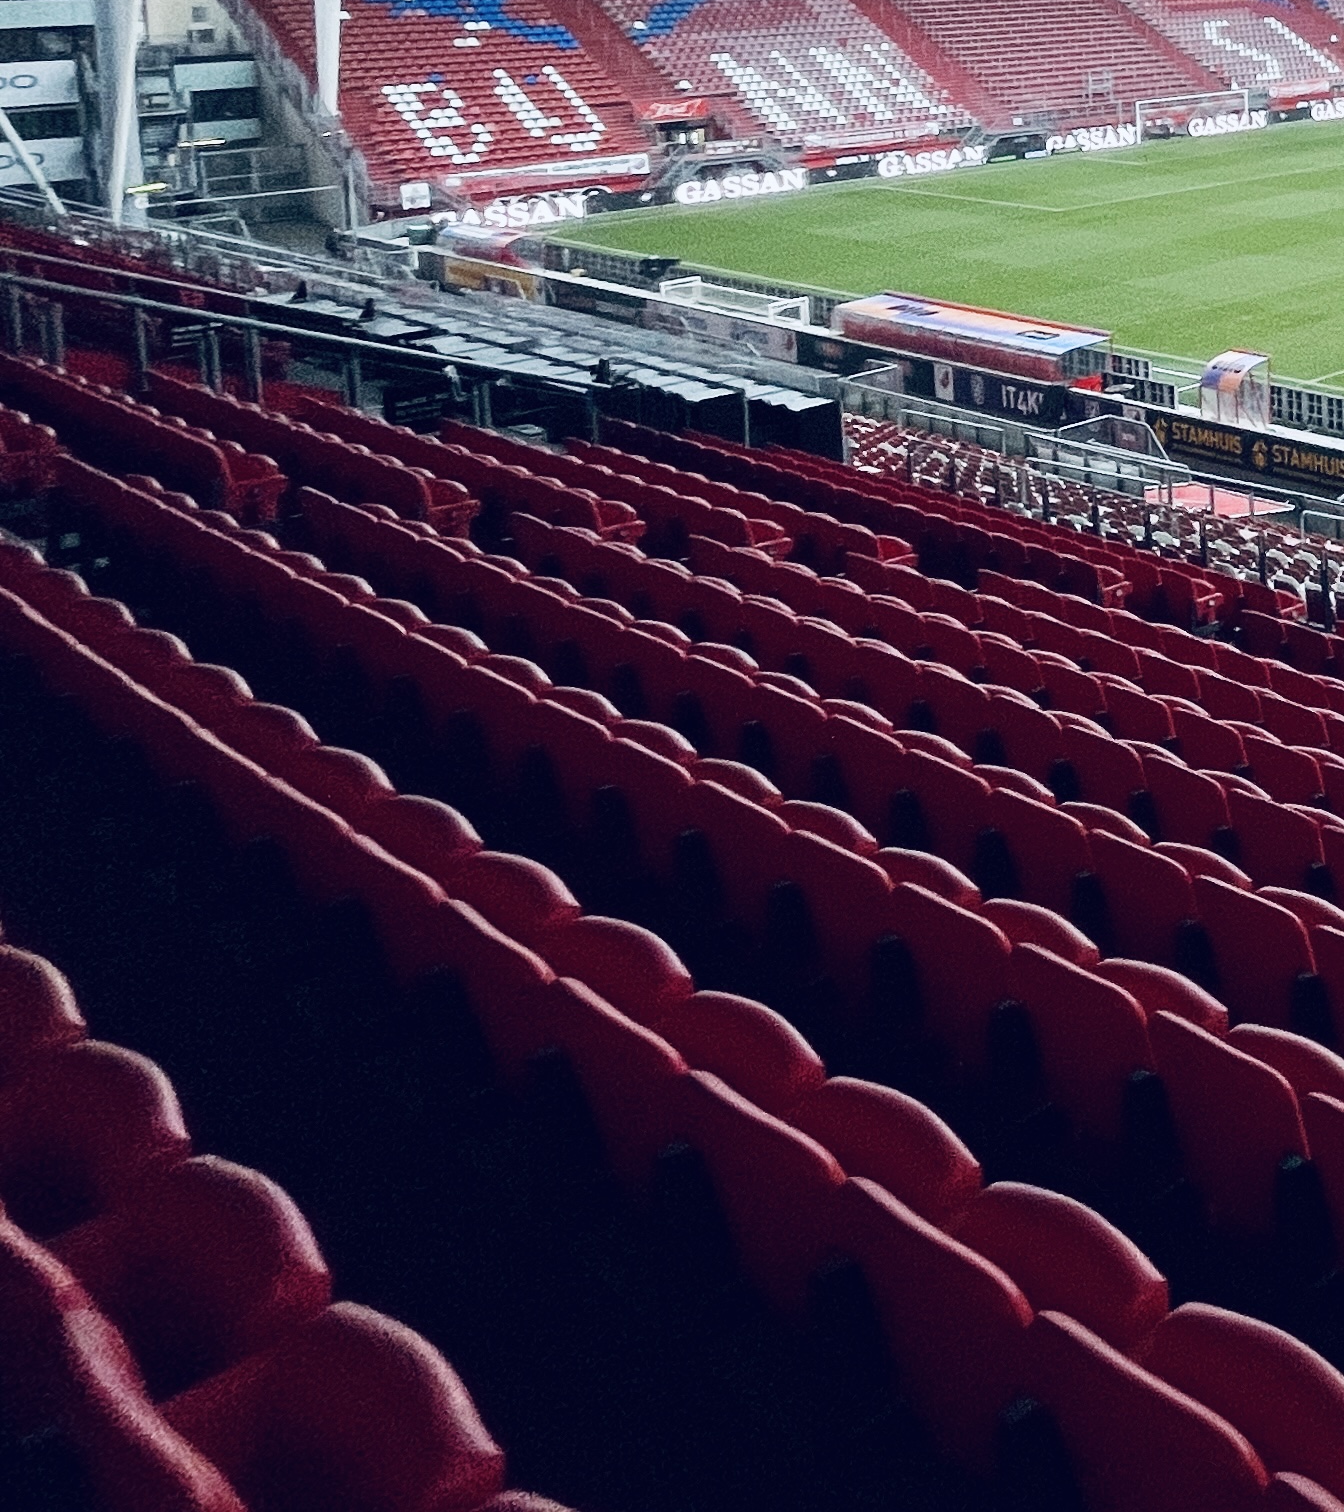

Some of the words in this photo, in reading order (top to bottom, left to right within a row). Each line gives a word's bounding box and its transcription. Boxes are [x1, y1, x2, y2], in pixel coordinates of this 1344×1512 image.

[1187, 110, 1269, 138] GASSAN
[877, 144, 989, 179] GASSAN
[674, 168, 808, 204] GASSAN
[1171, 422, 1243, 455] STAMHUIS
